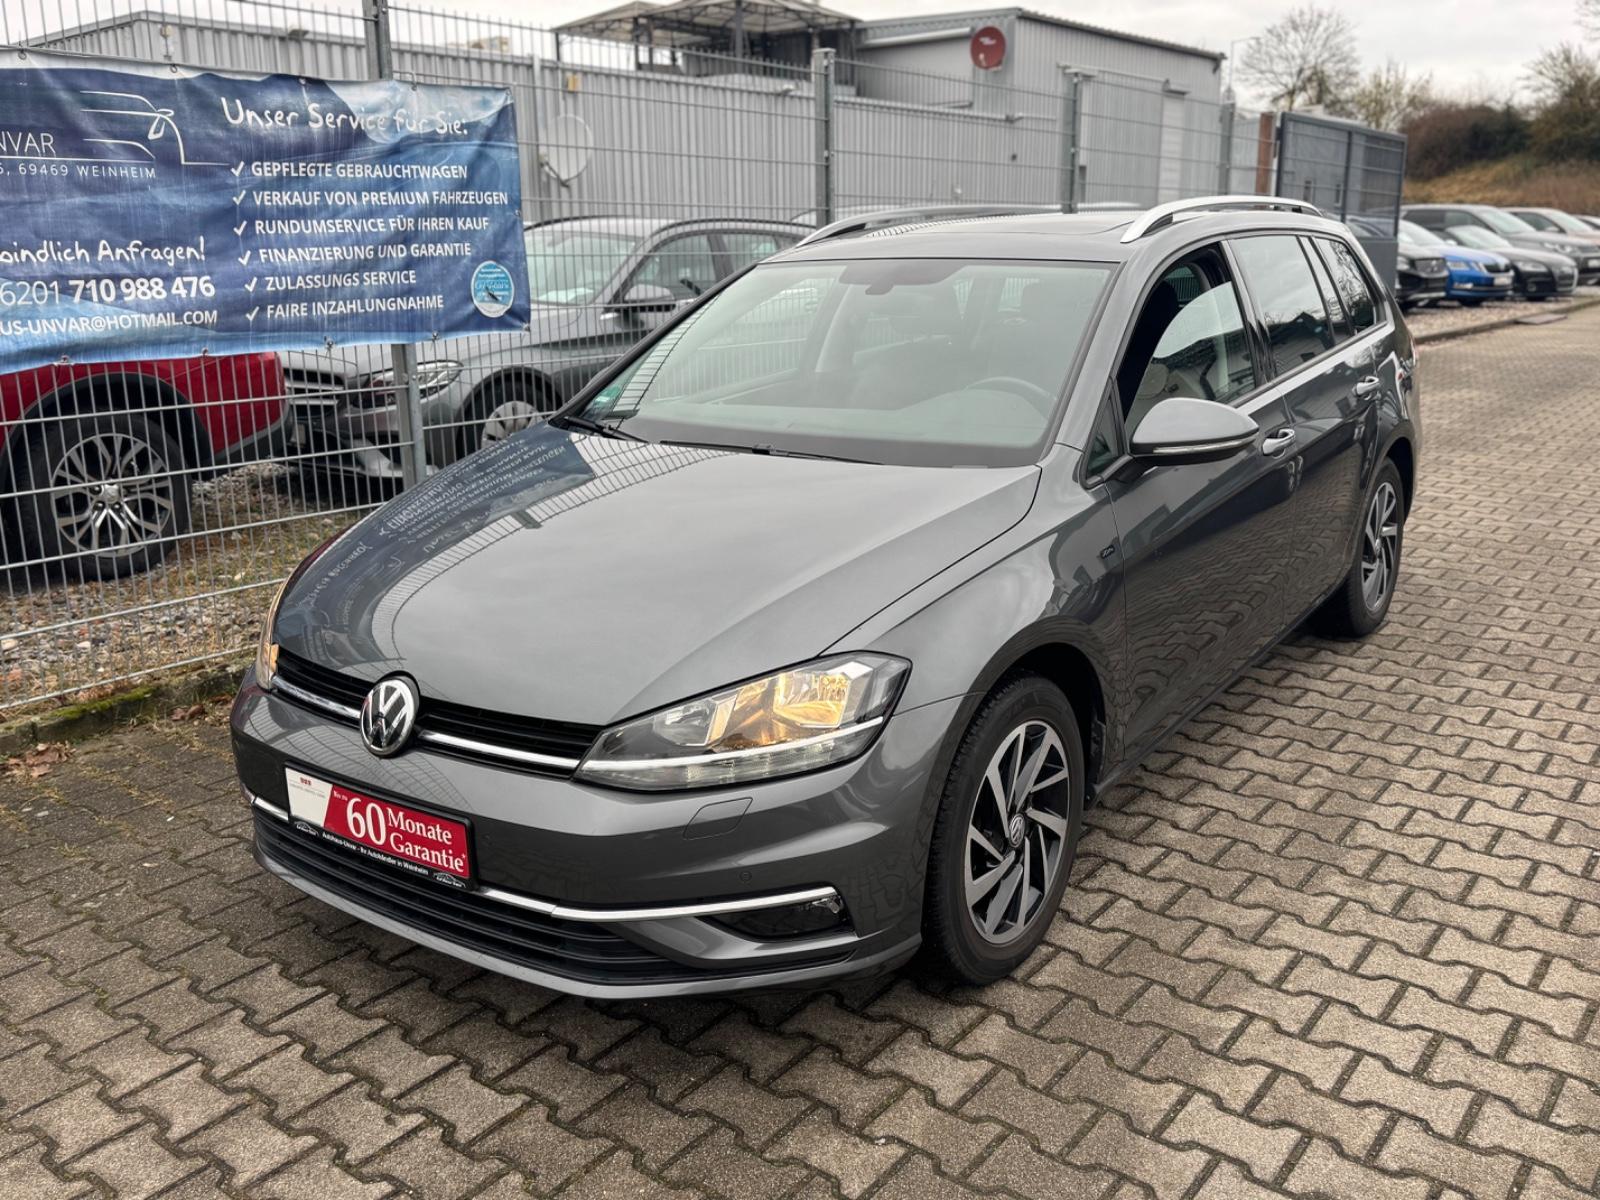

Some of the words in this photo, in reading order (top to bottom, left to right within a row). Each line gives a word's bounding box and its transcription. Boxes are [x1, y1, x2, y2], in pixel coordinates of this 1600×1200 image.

[220, 96, 299, 127] Unser
[307, 102, 387, 130] Service
[393, 110, 428, 132] für
[18, 162, 69, 177] 69469
[76, 165, 156, 179] WEINHEIM
[251, 161, 332, 178] GEPFLEGTE
[336, 163, 468, 179] GEBRAUCHTWAGEN
[253, 190, 321, 206] VERKAUF
[325, 191, 358, 206] VON
[362, 191, 430, 206] PREMIUM
[433, 191, 509, 205] FAHRZEUGEN
[255, 216, 386, 235] RUNDUMSERVICE
[389, 214, 415, 232] FÜR
[417, 216, 454, 231] IHREN
[457, 215, 490, 231] KAUF
[97, 235, 206, 267] Anfragen!
[259, 244, 374, 264] FINANZIERUNG
[378, 244, 405, 259] UND
[410, 242, 472, 257] GARANTIE
[0, 279, 59, 306] 6201
[69, 278, 117, 304] 710
[120, 276, 166, 301] 988
[171, 275, 215, 298] 476
[265, 272, 360, 291] ZULASSUNGS
[363, 269, 417, 286] SERVICE
[266, 301, 308, 319] FAIRE
[312, 294, 444, 316] INZAHLUNGNAHME
[346, 797, 387, 846] 60
[387, 807, 453, 846] Monate
